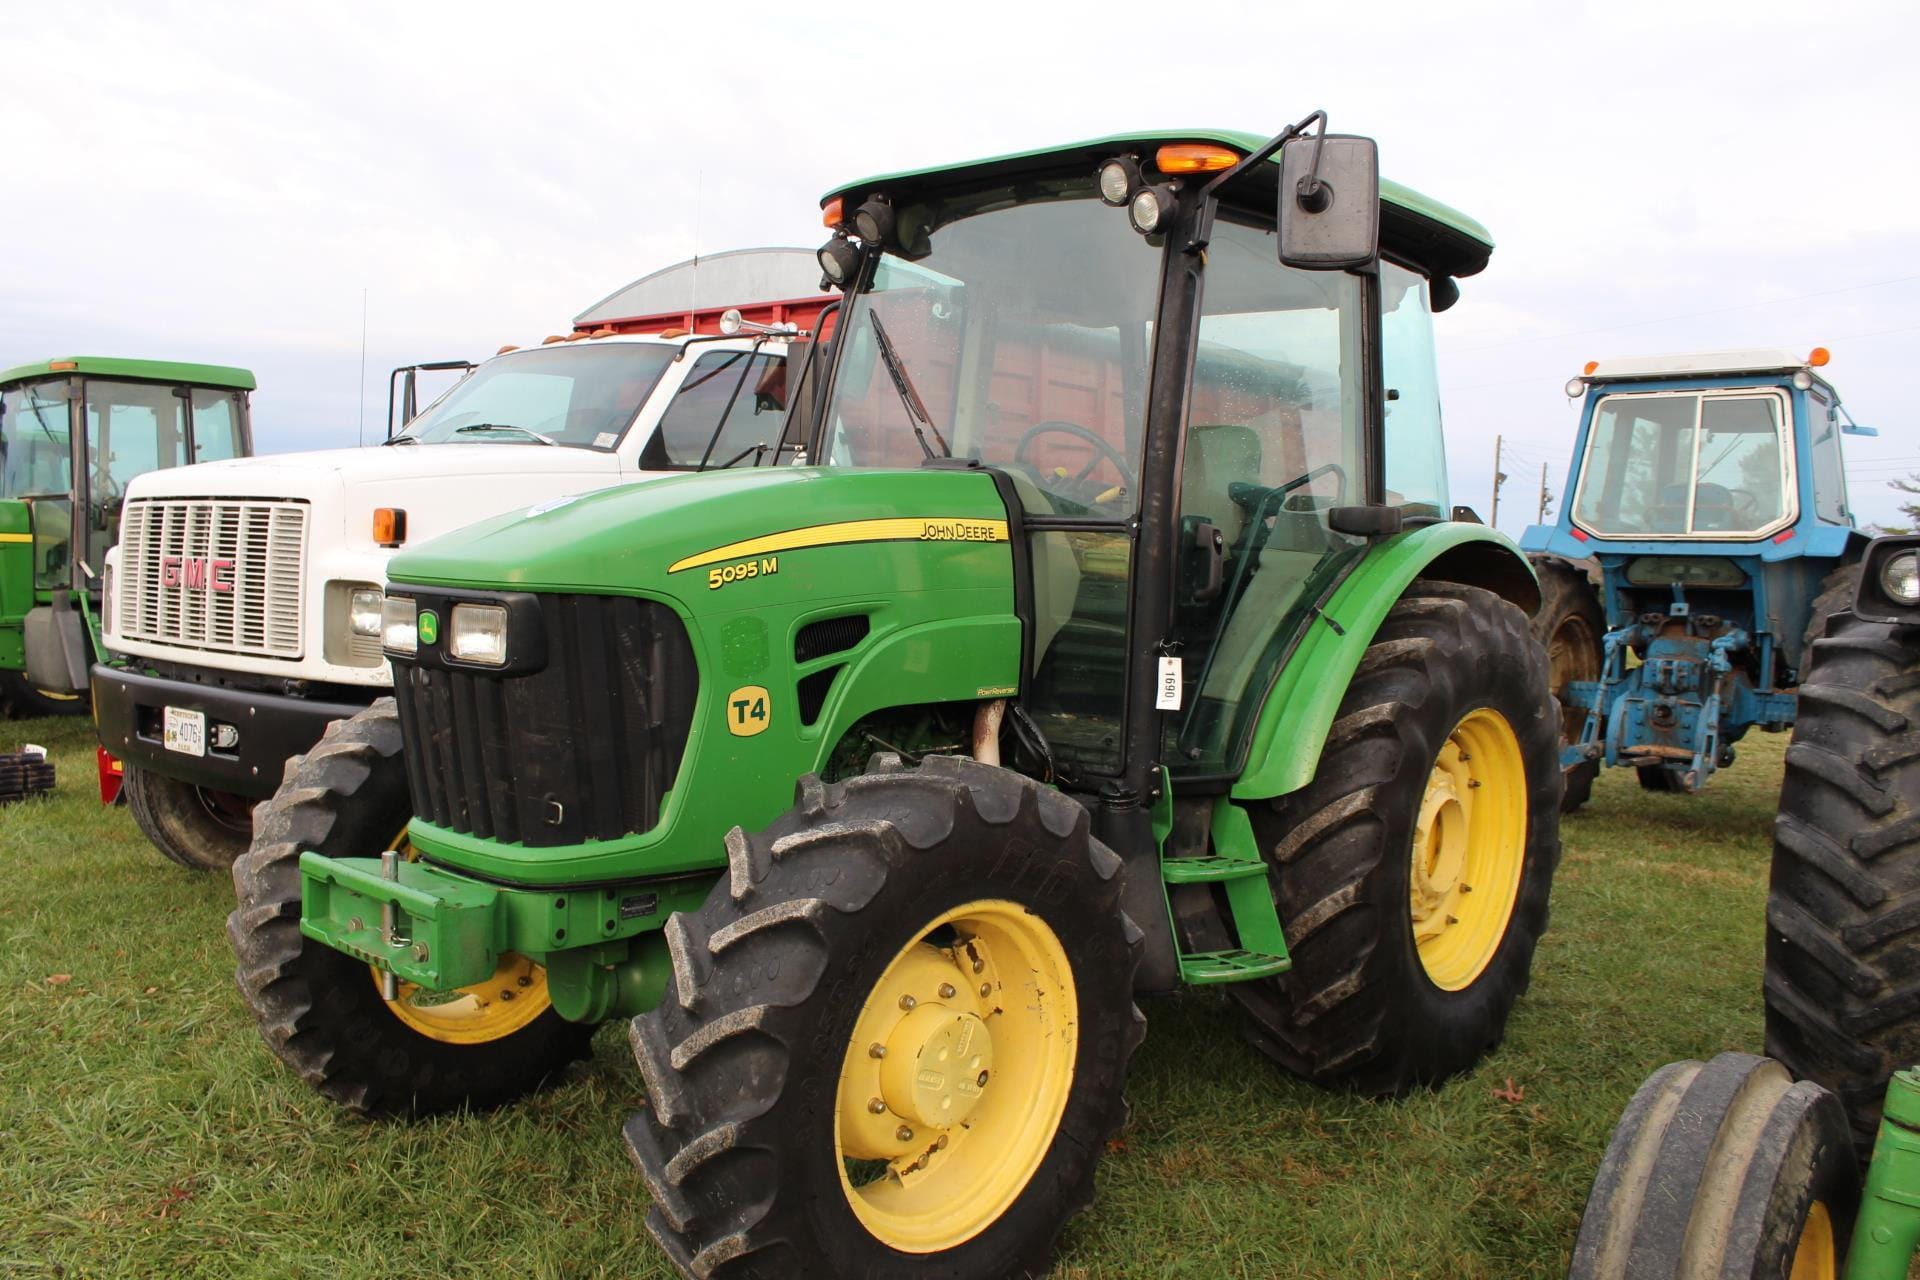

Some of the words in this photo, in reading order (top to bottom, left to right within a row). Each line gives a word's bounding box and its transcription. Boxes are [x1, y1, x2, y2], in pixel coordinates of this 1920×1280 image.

[920, 522, 955, 538] JOHN
[955, 523, 996, 539] DEERE
[162, 557, 233, 592] GMC
[709, 561, 759, 590] 5095
[762, 557, 778, 576] M
[1165, 671, 1176, 698] 1690
[733, 697, 766, 724] T4
[179, 721, 198, 744] 4076
